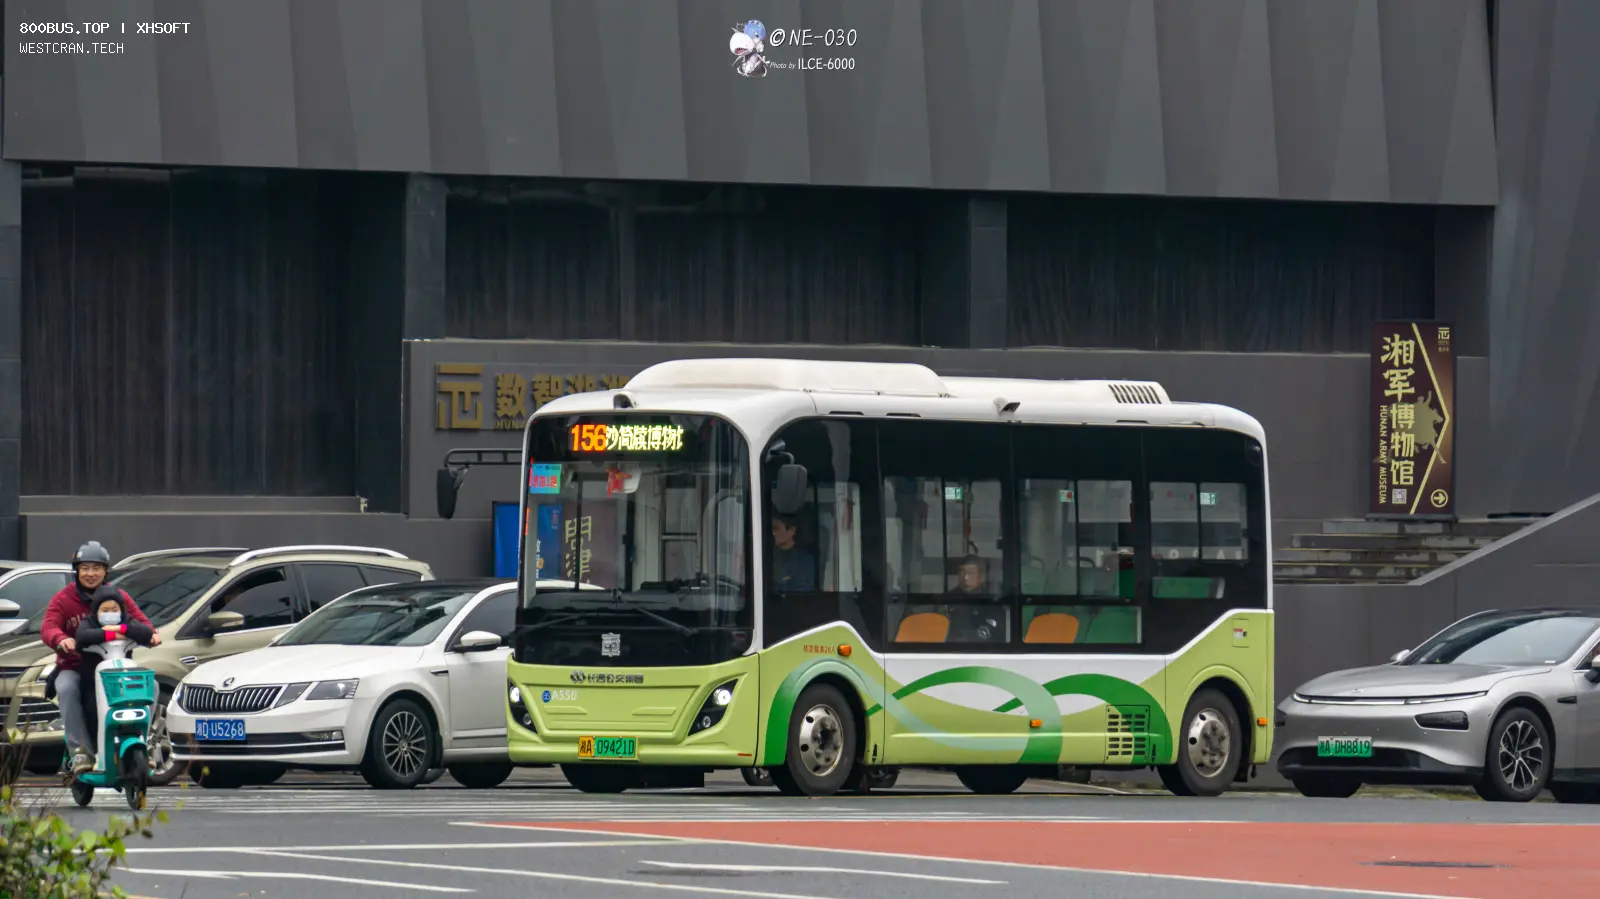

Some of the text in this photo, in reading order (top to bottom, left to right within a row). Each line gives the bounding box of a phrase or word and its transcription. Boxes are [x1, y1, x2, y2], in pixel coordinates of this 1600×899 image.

[571, 424, 607, 452] 156
[1378, 405, 1388, 504] HUNAN ARMY MUSEUM
[1380, 333, 1416, 486] 湘军博物馆
